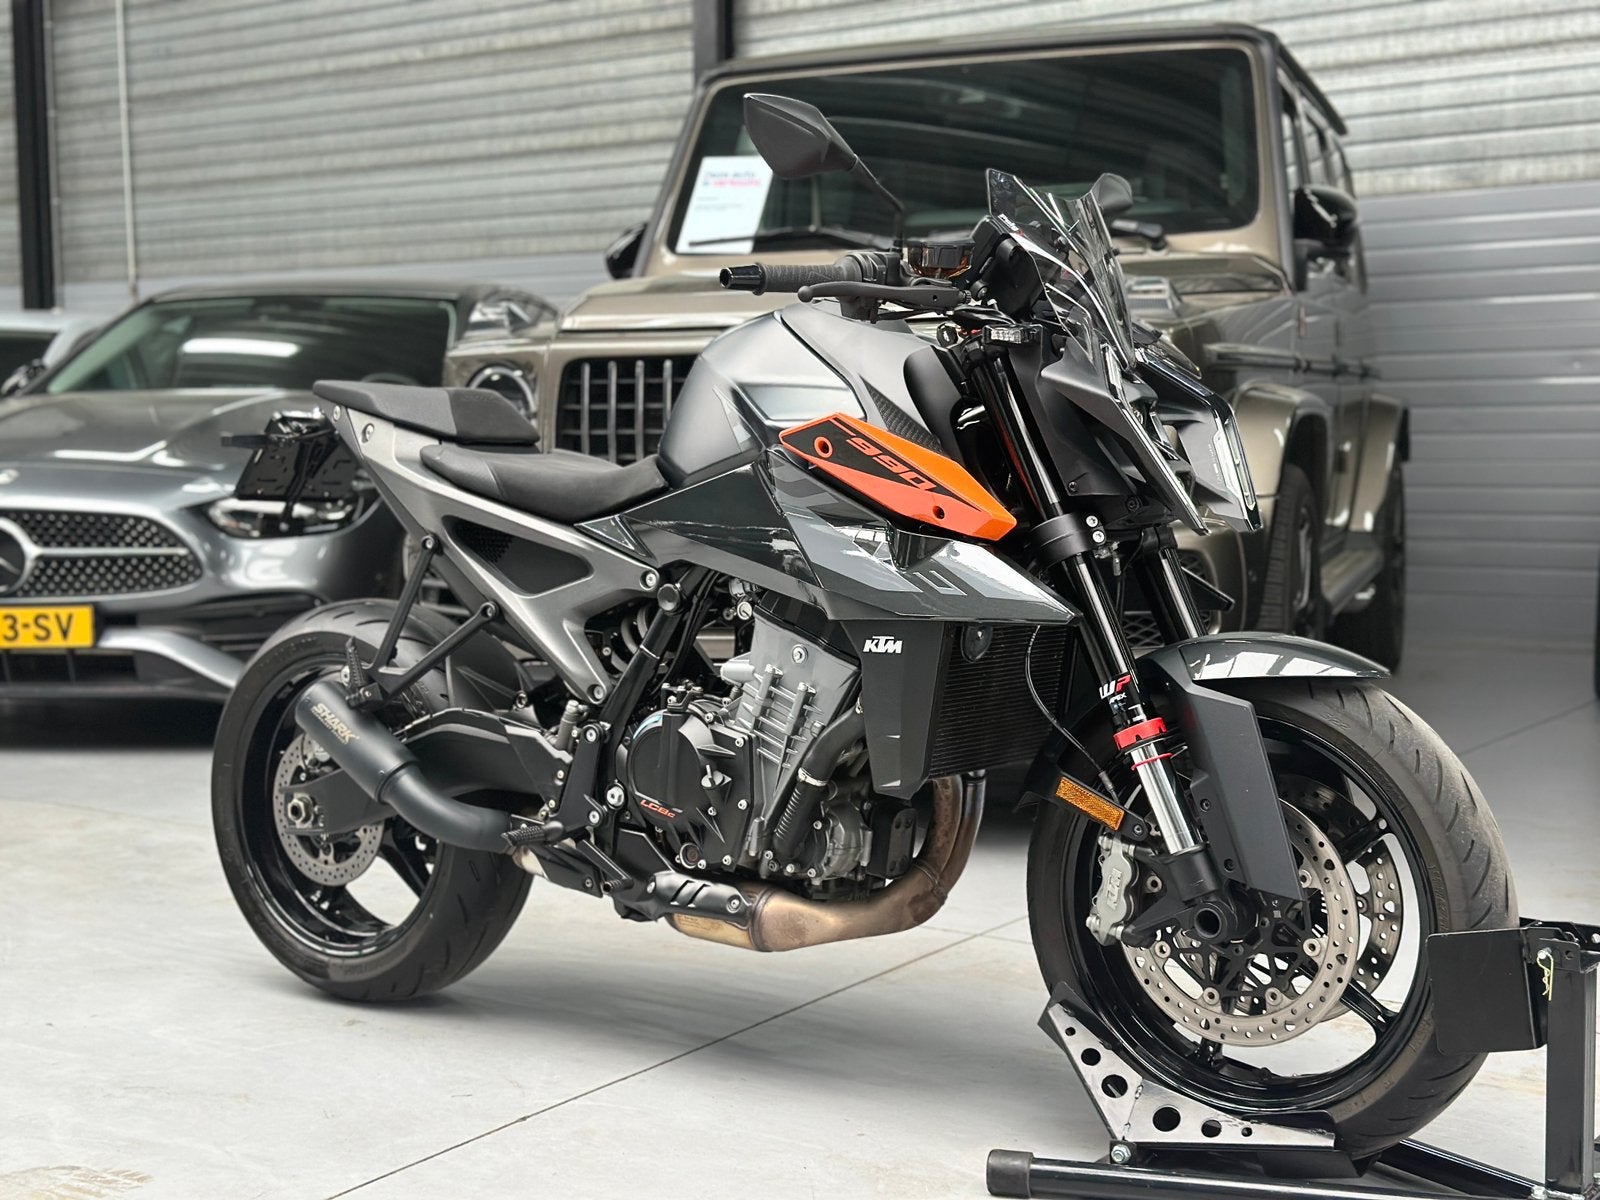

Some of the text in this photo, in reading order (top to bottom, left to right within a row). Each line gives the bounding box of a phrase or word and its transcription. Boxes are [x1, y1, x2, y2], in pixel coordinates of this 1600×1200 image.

[846, 437, 937, 491] 990
[2, 613, 73, 641] 3-SV
[862, 635, 903, 654] KTM
[1098, 674, 1132, 700] WP
[310, 703, 360, 743] SHARK
